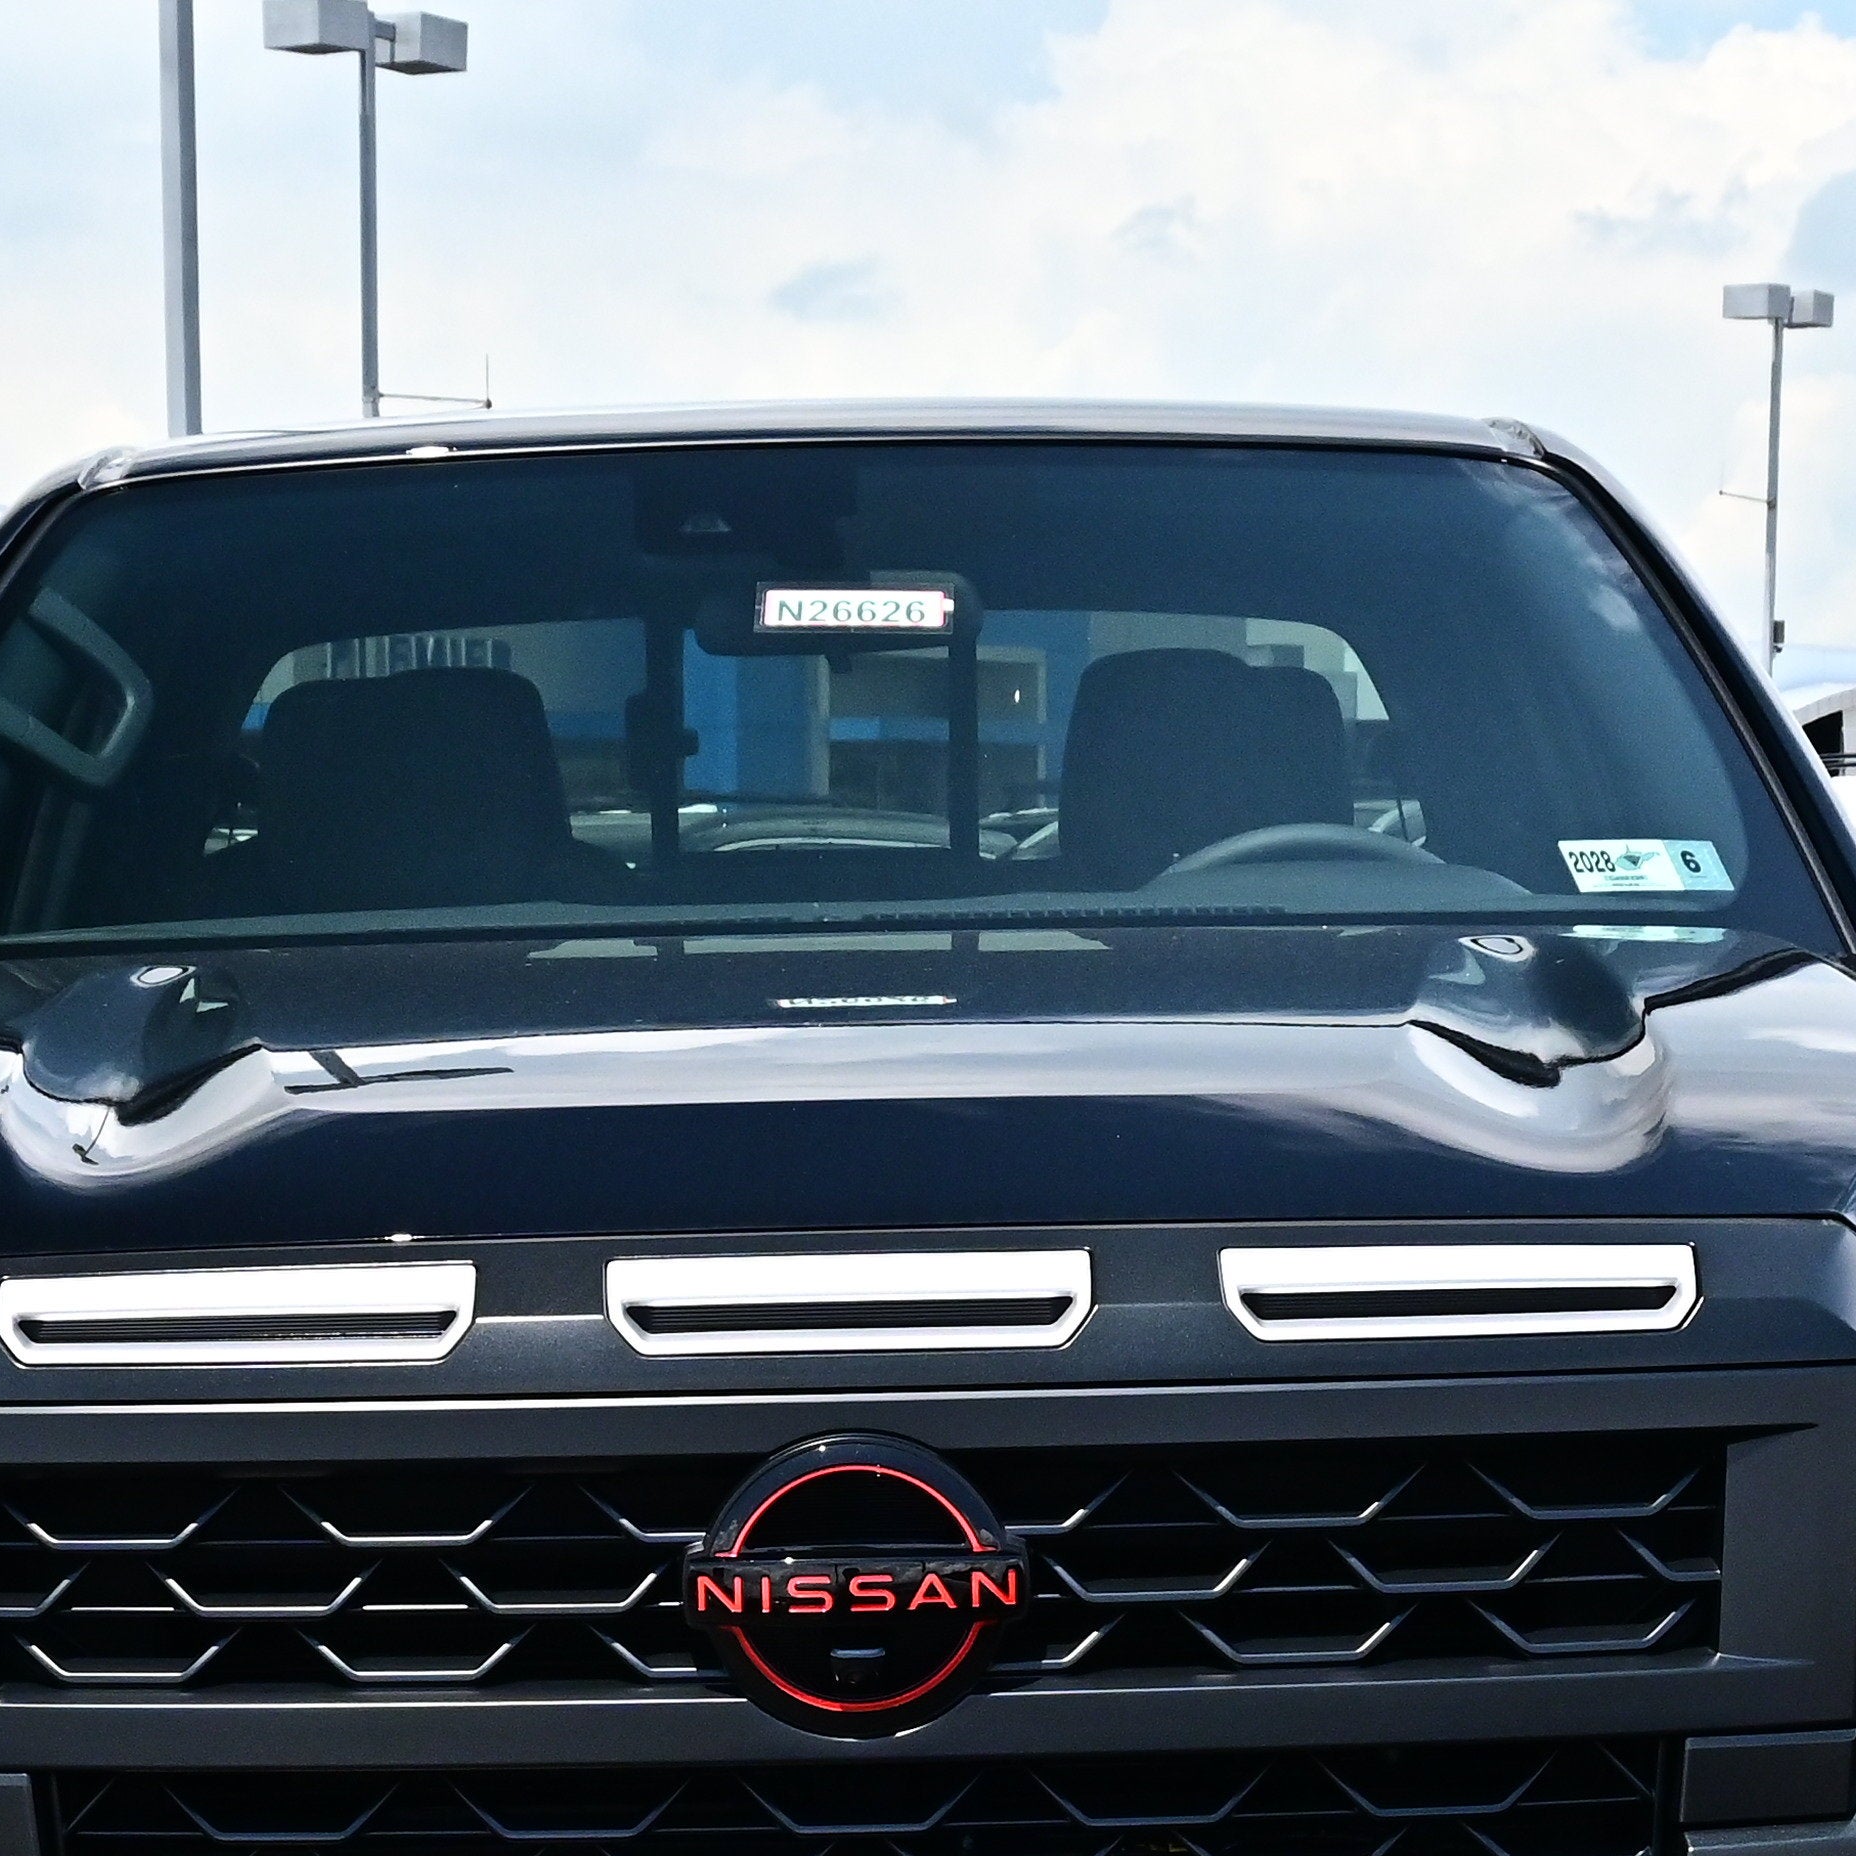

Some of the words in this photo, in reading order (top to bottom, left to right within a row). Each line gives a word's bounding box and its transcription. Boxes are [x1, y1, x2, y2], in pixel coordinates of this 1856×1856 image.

[777, 599, 926, 623] N26626
[1568, 850, 1616, 873] 2028
[1680, 850, 1702, 873] 6
[696, 1568, 1017, 1613] NISSAN
